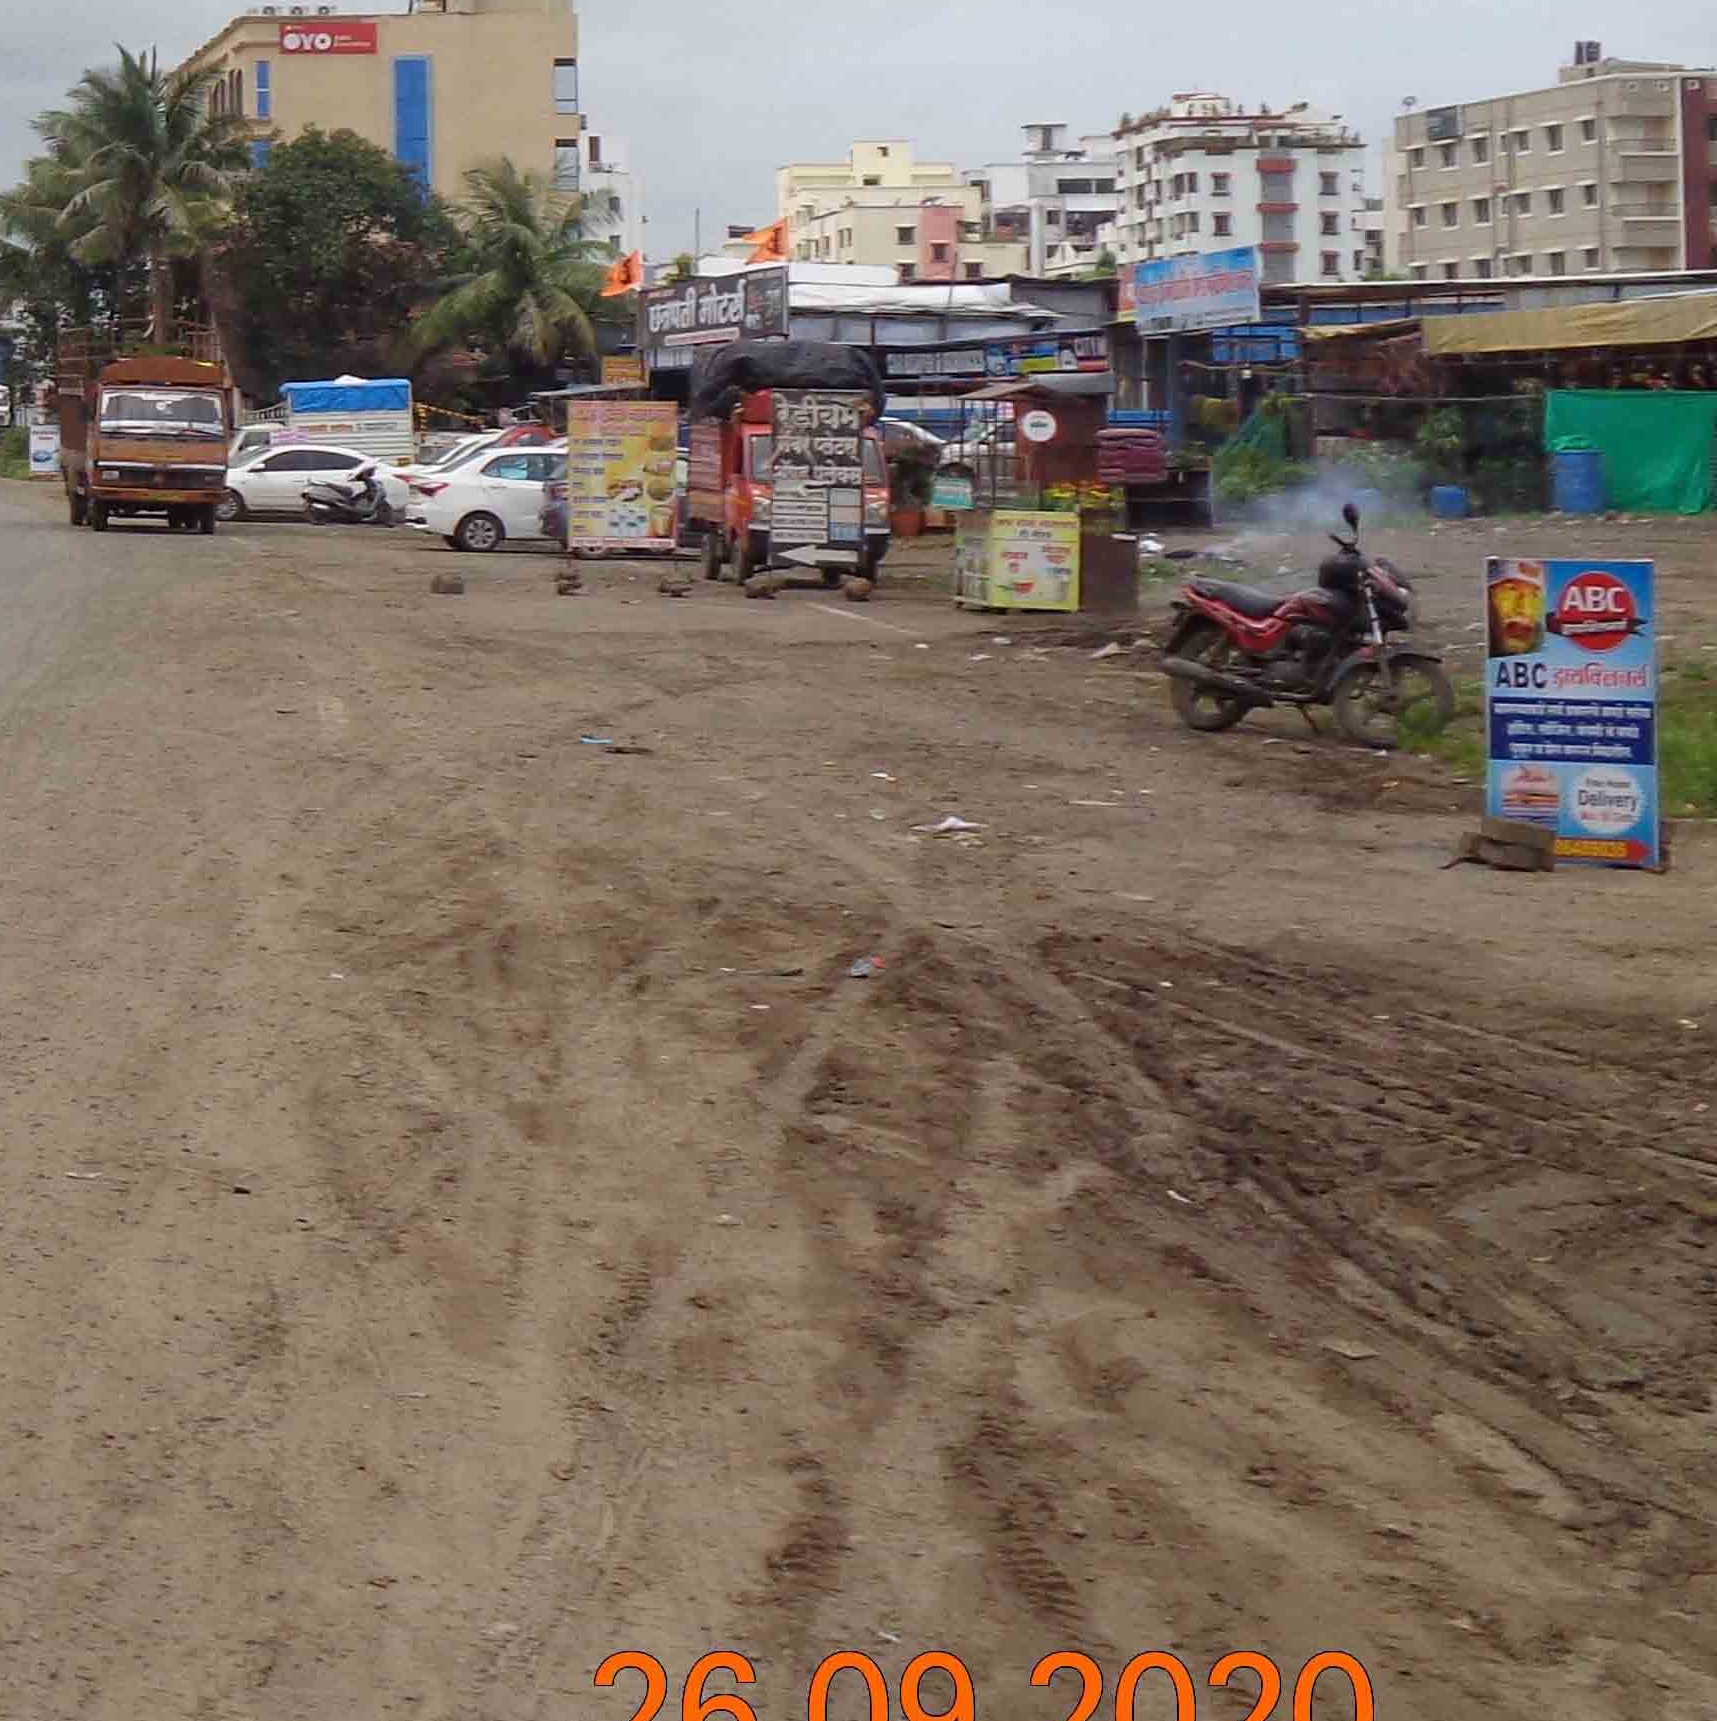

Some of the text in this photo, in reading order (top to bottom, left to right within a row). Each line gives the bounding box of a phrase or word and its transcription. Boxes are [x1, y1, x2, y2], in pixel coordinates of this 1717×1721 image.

[283, 32, 333, 51] OYO
[1562, 585, 1627, 613] ABC
[1495, 661, 1549, 689] ABC
[1578, 789, 1637, 812] Delivery
